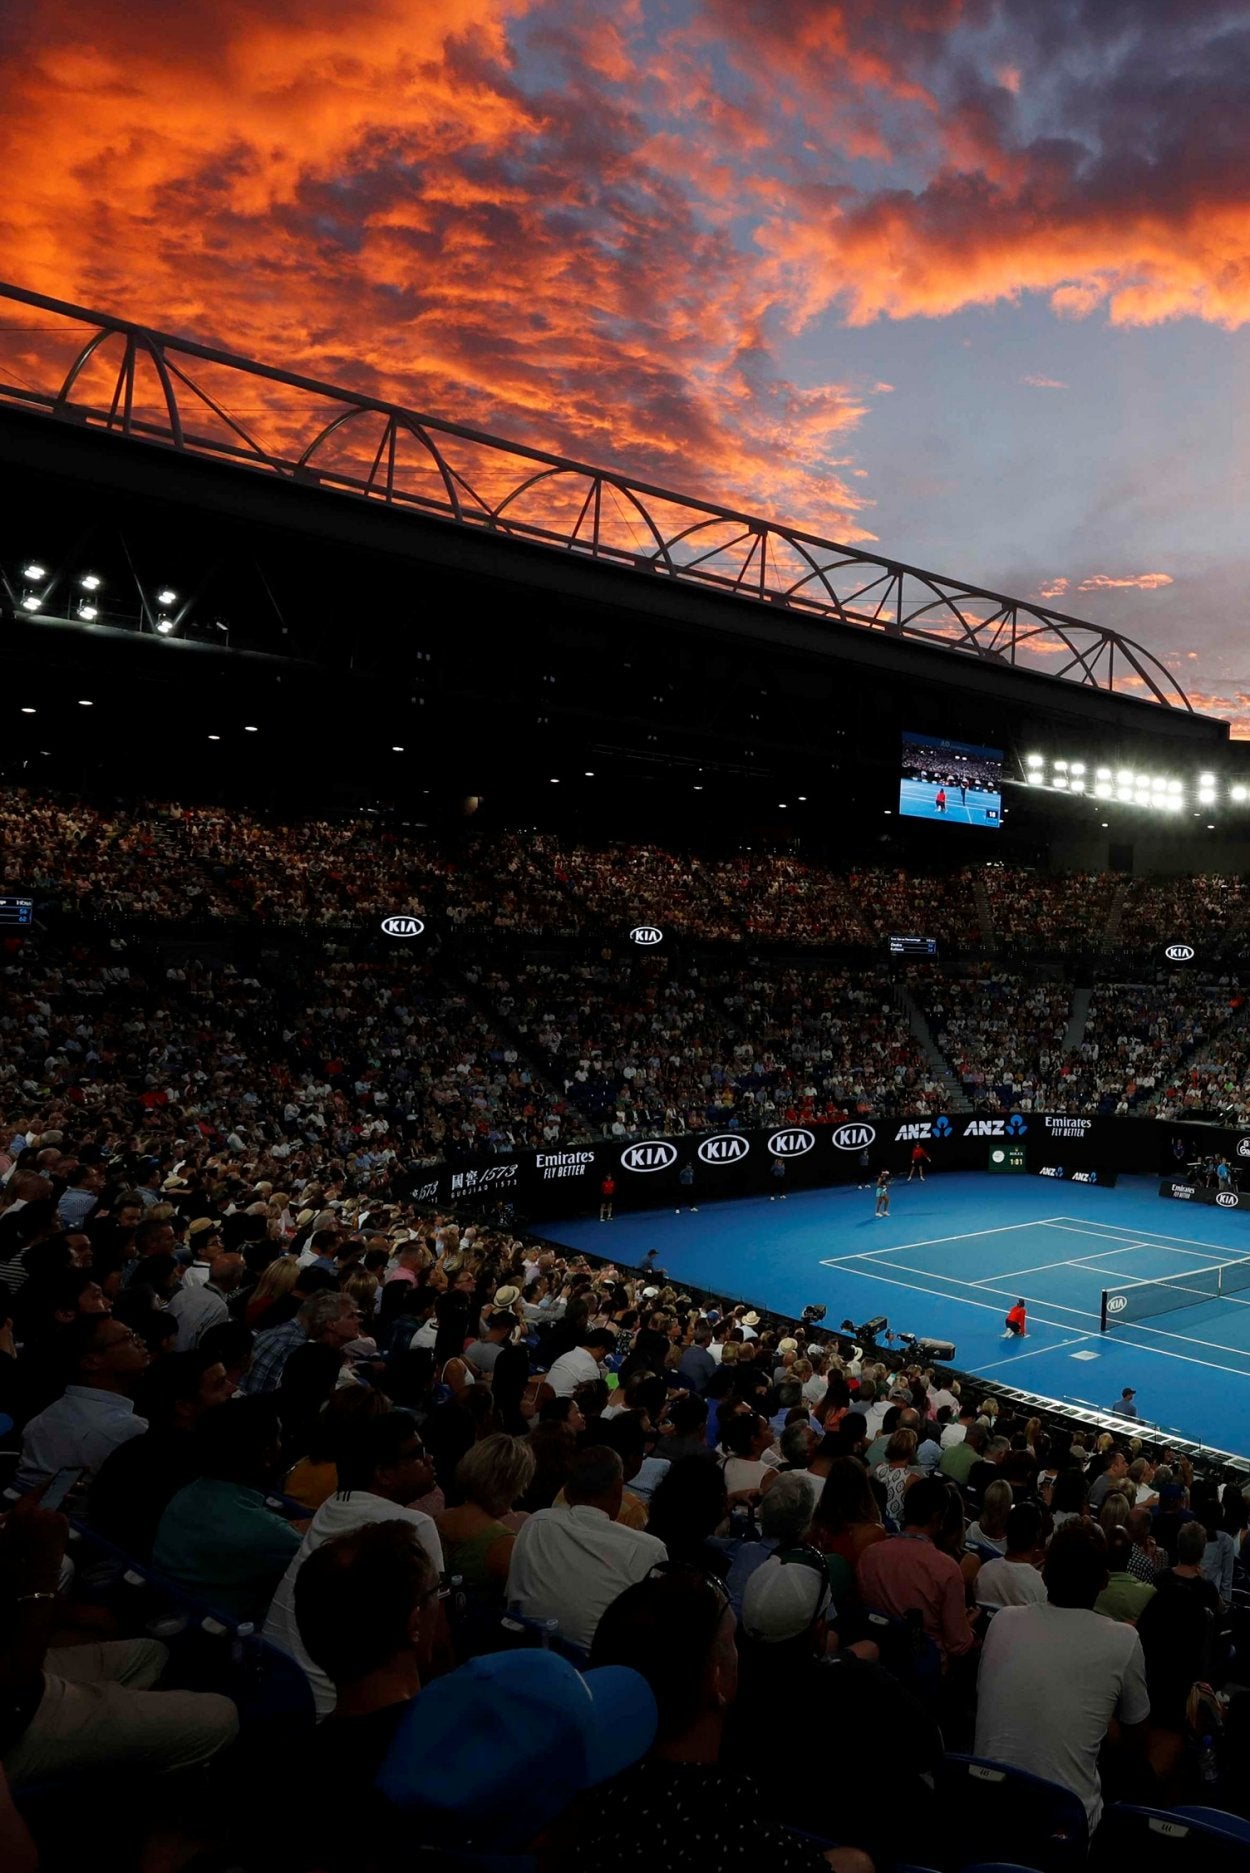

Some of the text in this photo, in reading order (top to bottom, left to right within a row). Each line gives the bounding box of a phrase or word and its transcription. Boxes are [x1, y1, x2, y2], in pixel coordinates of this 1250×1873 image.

[389, 921, 416, 933] KIA
[635, 930, 657, 941] KIA
[1169, 948, 1190, 957] KIA
[963, 1120, 1005, 1136] ANZ
[1045, 1116, 1092, 1128] Emirates
[840, 1128, 868, 1145] KIA
[894, 1122, 931, 1141] ANZ
[1051, 1128, 1085, 1137] FLY BETTER
[776, 1133, 807, 1152] KIA
[707, 1140, 740, 1159] KIA
[536, 1151, 595, 1168] Emirates
[630, 1147, 668, 1167] KIA
[544, 1164, 585, 1179] FLY BETTER
[1039, 1166, 1056, 1177] ANZ
[1072, 1171, 1089, 1183] ANZ
[1220, 1196, 1235, 1204] KIA
[1110, 1299, 1124, 1310] KIA
